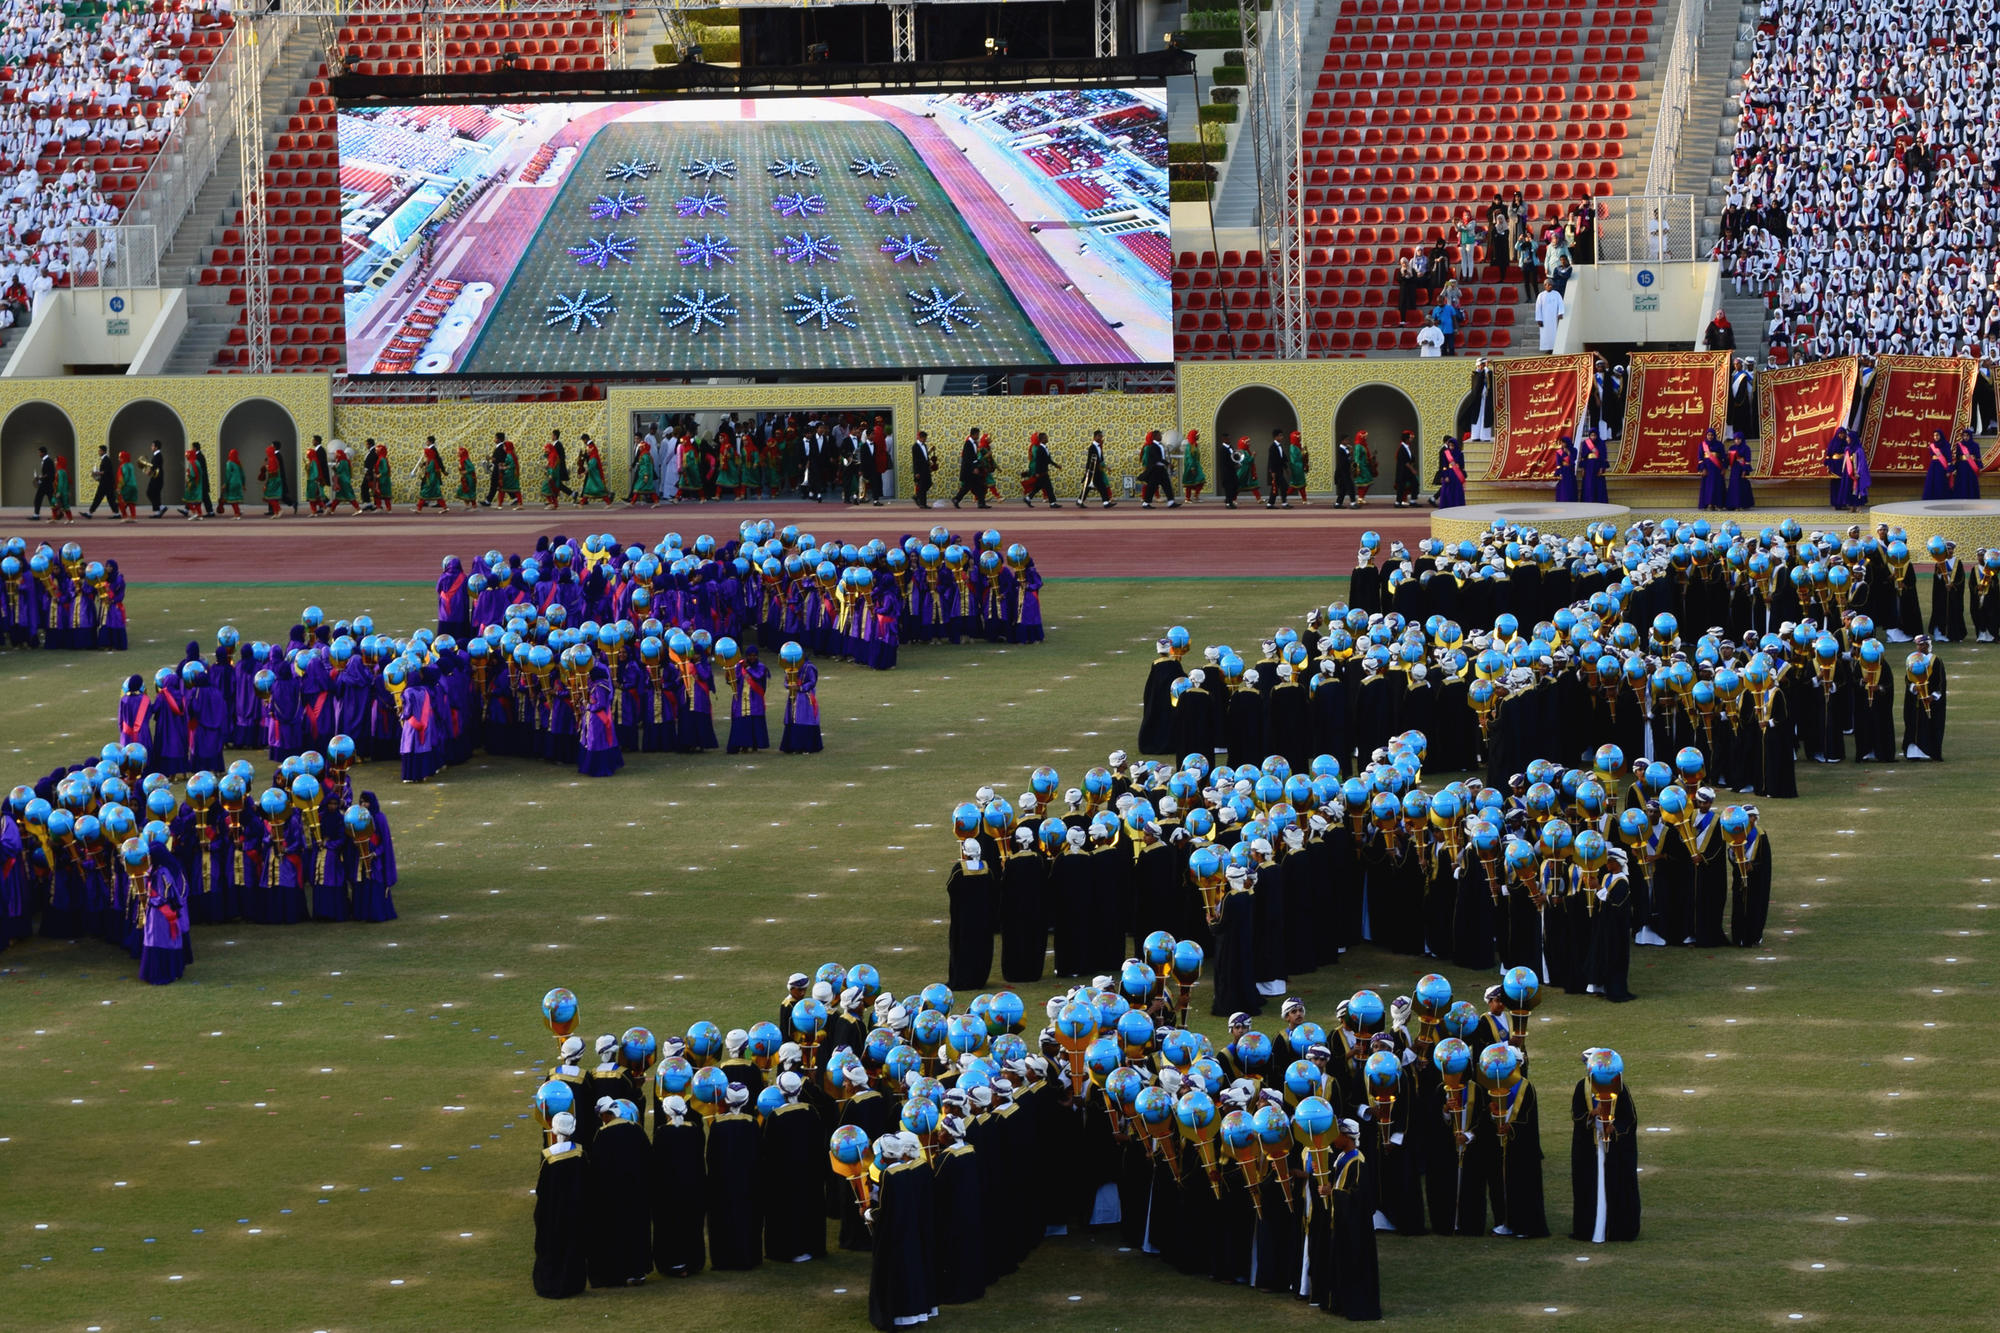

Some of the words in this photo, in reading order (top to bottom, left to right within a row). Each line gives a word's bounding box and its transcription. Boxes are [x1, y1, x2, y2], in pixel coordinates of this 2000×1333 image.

[1640, 273, 1651, 284] 15
[1657, 386, 1697, 396] السلطان
[1647, 396, 1703, 419] قابوس
[1784, 401, 1834, 421] سلطنة
[1885, 405, 1914, 417] عمان
[1915, 408, 1952, 420] سلطان
[1780, 417, 1837, 442] عمان
